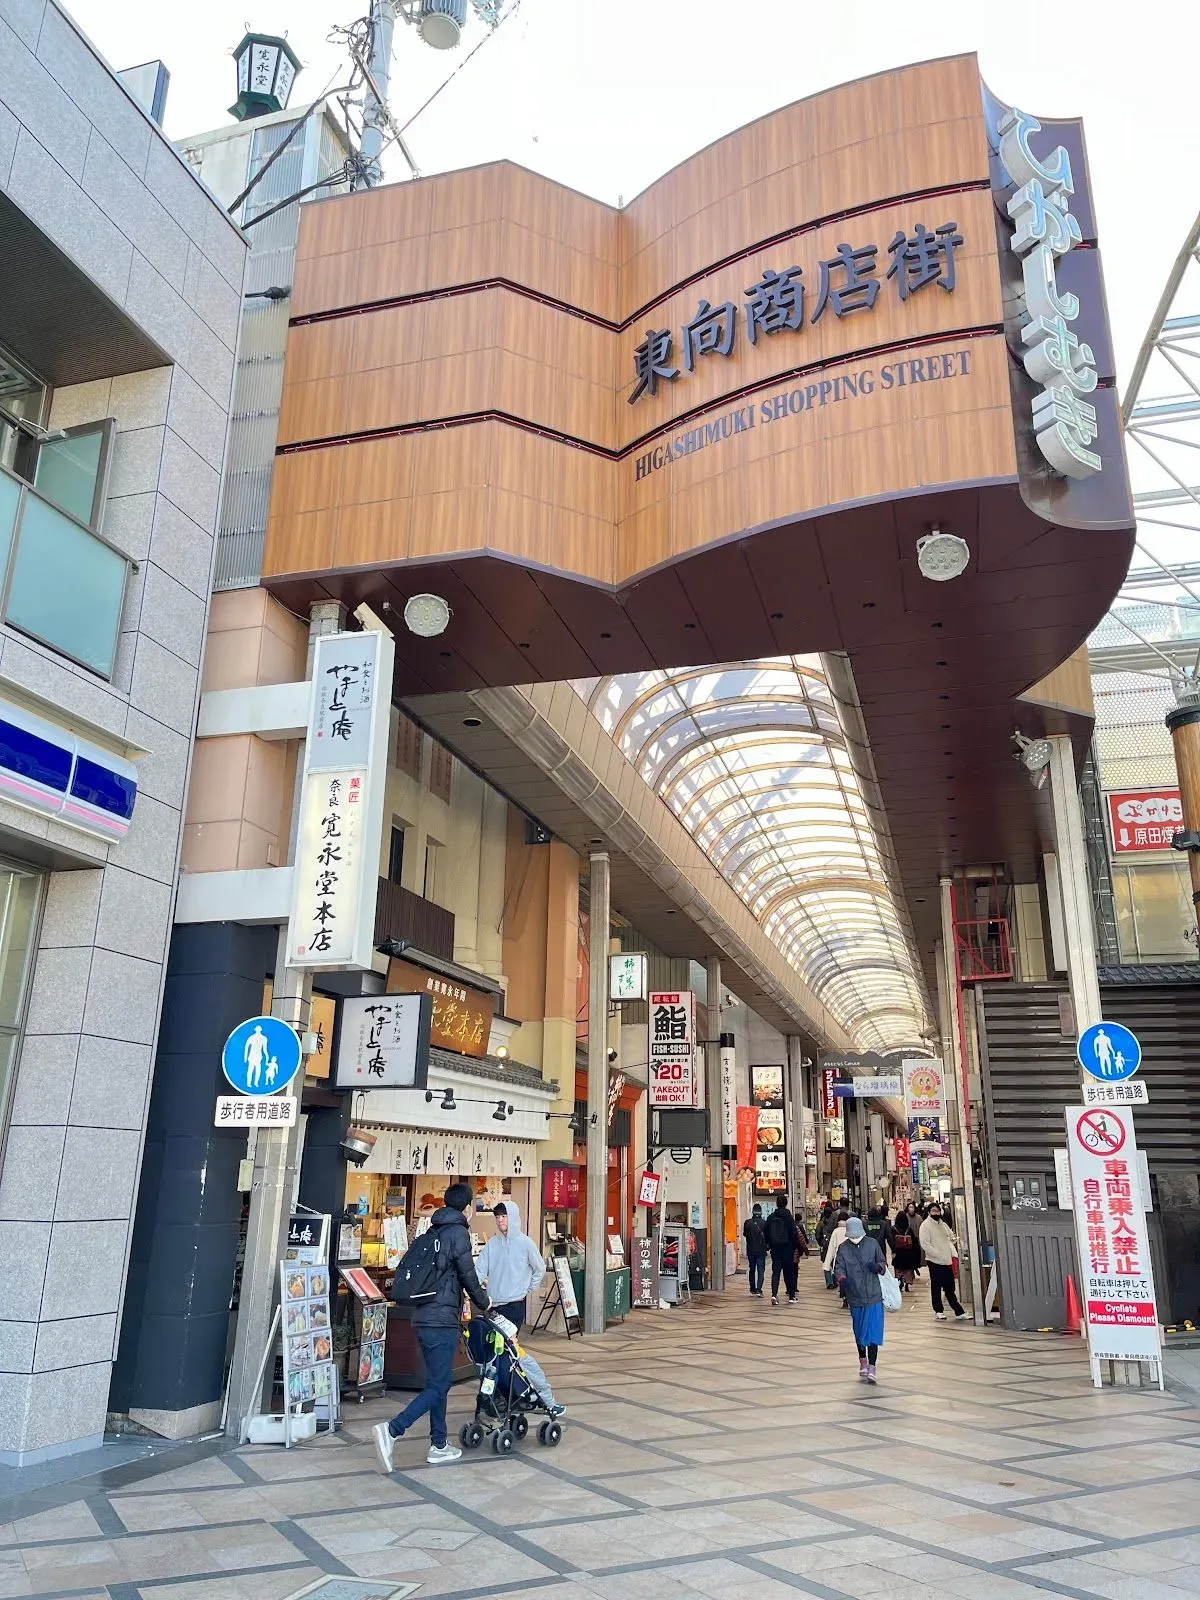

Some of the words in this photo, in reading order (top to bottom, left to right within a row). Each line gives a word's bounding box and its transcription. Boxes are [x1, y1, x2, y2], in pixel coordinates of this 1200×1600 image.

[999, 107, 1102, 480] ひがしむき
[627, 221, 964, 405] 東向商店街
[635, 404, 756, 482] HIGASHIMUKI
[760, 368, 875, 426] SHOPPING
[880, 350, 972, 391] STREET
[326, 664, 359, 741] やまと庵
[328, 778, 342, 808] 奈良
[348, 777, 361, 803] 菓匠
[308, 812, 343, 952] 寛永堂本店
[653, 1005, 687, 1041] 鮨
[364, 1004, 392, 1078] やまと庵
[1086, 1084, 1143, 1101] 歩行者用道路
[220, 1101, 291, 1120] 歩行者用道路
[1083, 1178, 1110, 1274] 自行車請推行
[1103, 1158, 1142, 1276] 車両乗入禁止
[639, 1238, 652, 1269] 柿の葉
[640, 1278, 653, 1299] 茶屋
[1089, 1278, 1148, 1289] 自転車は押して
[1090, 1289, 1149, 1298] 通行して下さい
[1090, 1313, 1116, 1321] Please
[1117, 1314, 1156, 1323] Dismount
[1105, 1304, 1137, 1313] Cyclists
